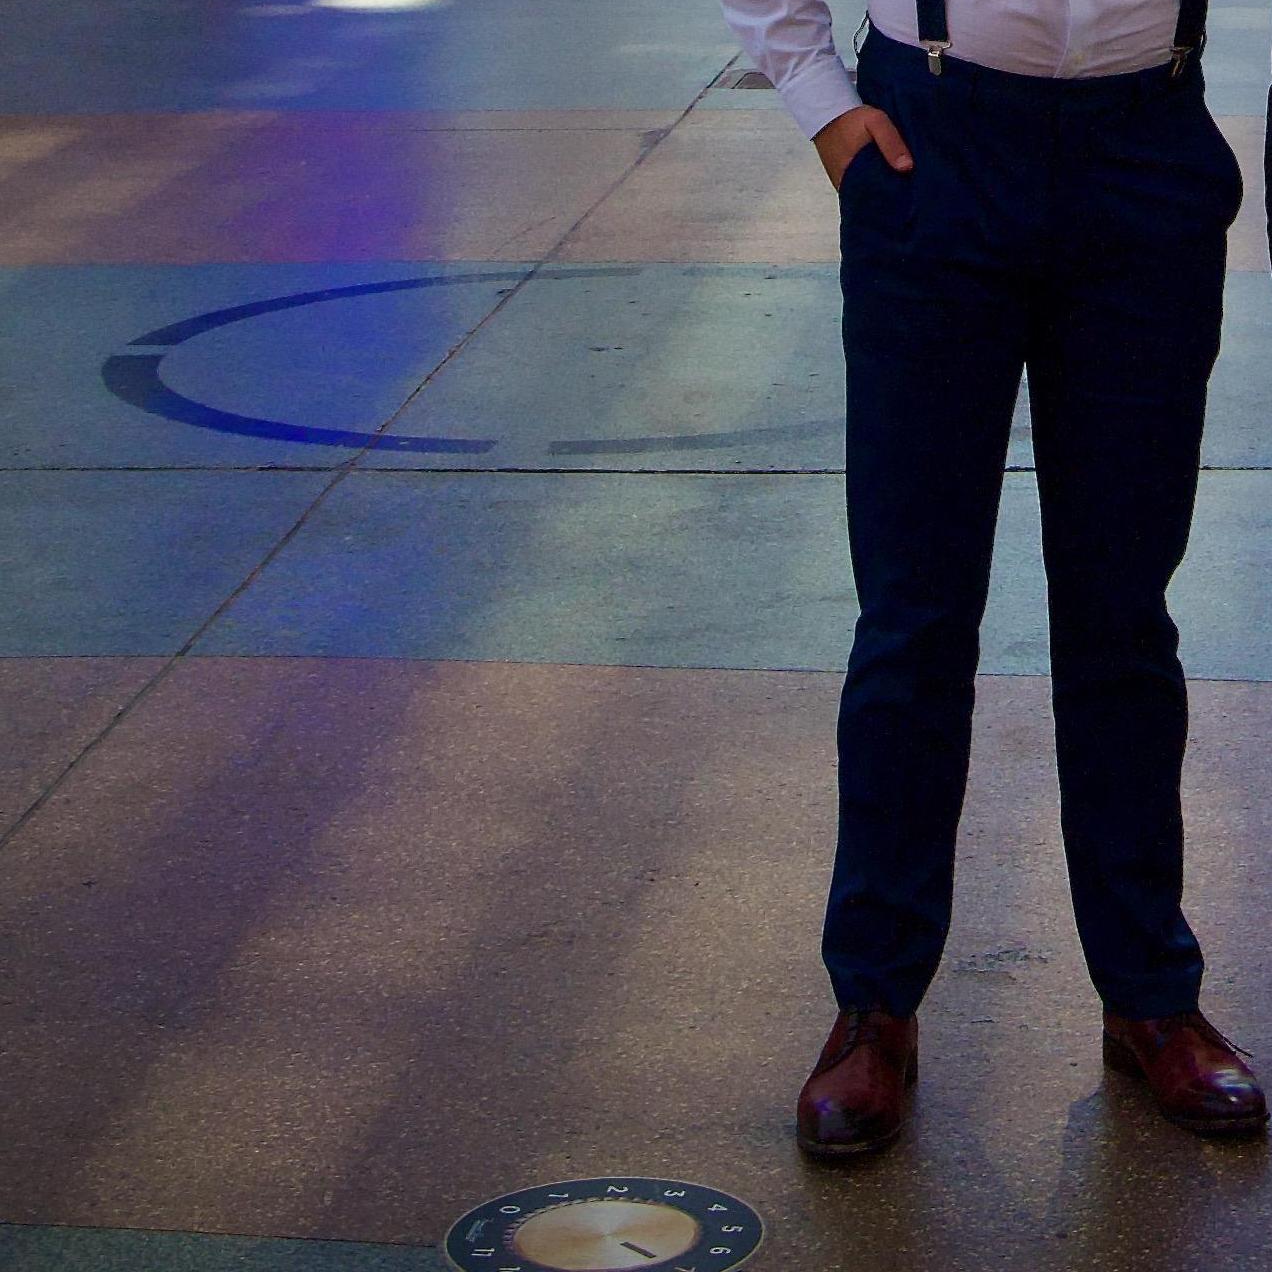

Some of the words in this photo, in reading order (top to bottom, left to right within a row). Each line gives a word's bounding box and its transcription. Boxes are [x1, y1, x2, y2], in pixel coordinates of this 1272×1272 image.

[607, 1185, 629, 1193] 2
[664, 1189, 686, 1197] 3
[707, 1203, 728, 1212] 4
[721, 1224, 744, 1233] 5
